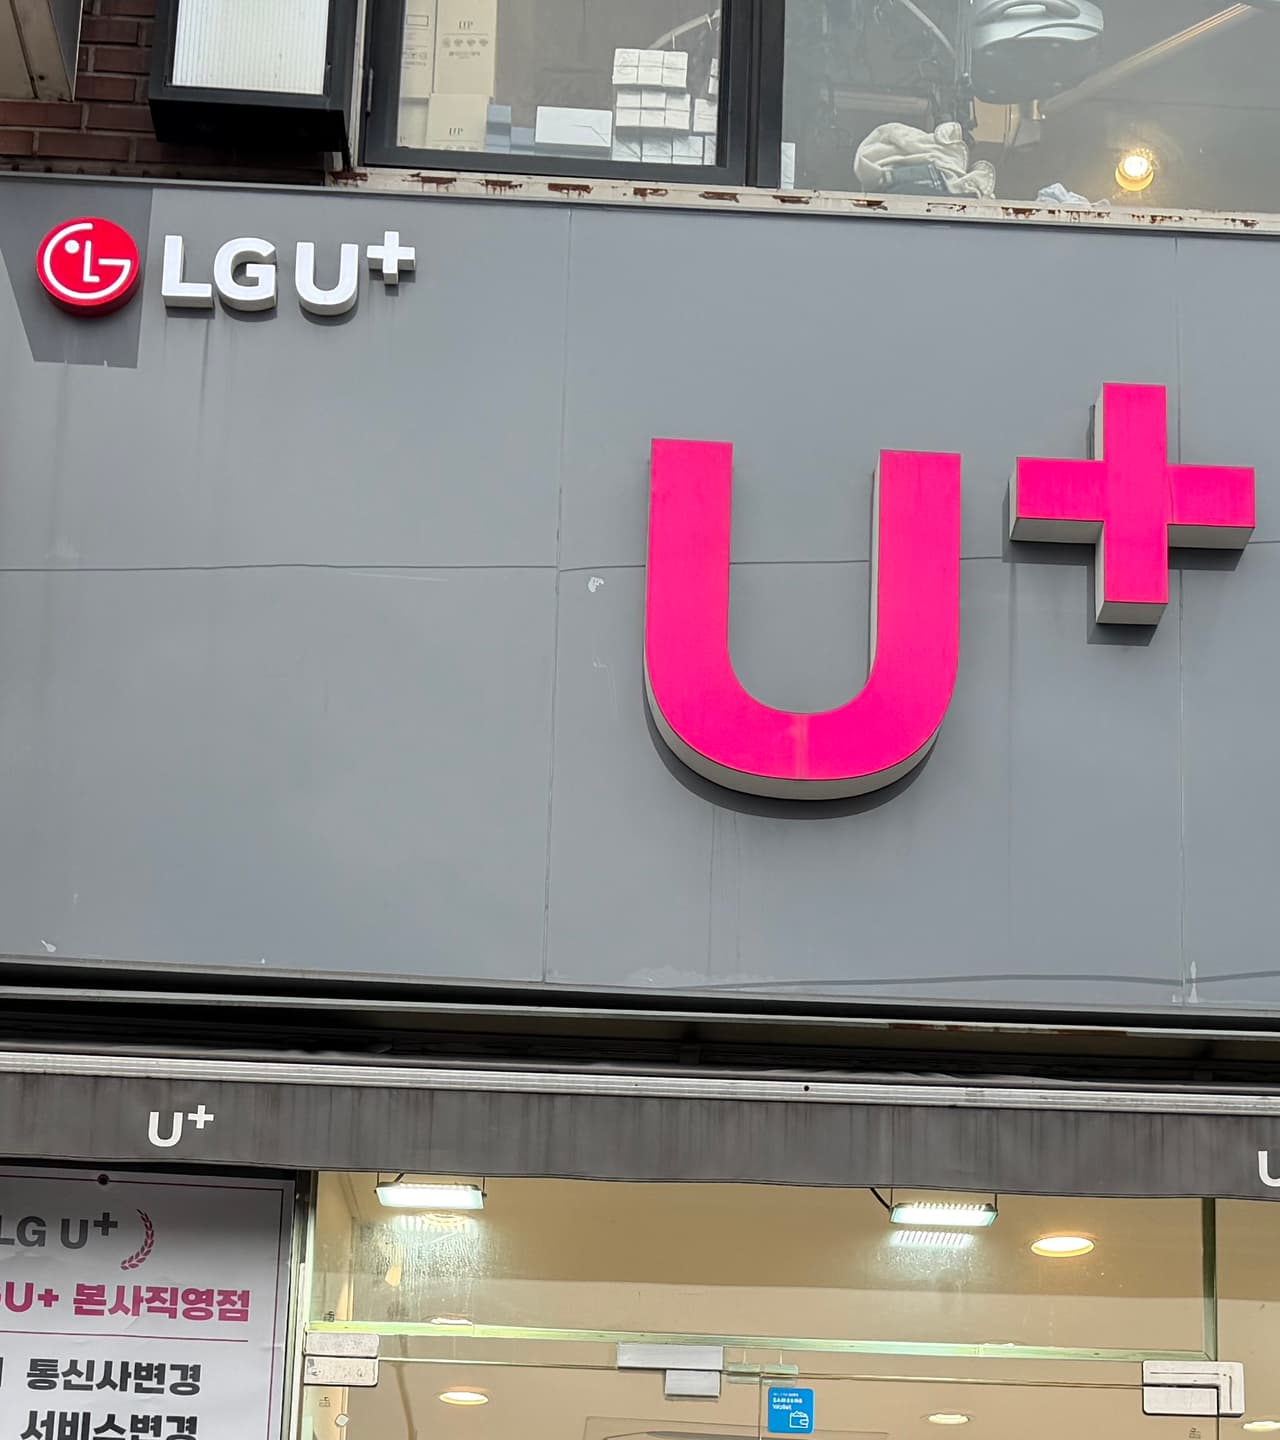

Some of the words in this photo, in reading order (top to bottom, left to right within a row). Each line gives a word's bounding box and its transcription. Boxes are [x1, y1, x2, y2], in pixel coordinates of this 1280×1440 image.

[644, 382, 1257, 803] U+
[147, 1104, 214, 1149] U+
[72, 1283, 251, 1322] 본사직영점
[25, 1356, 203, 1396] 통신사변경
